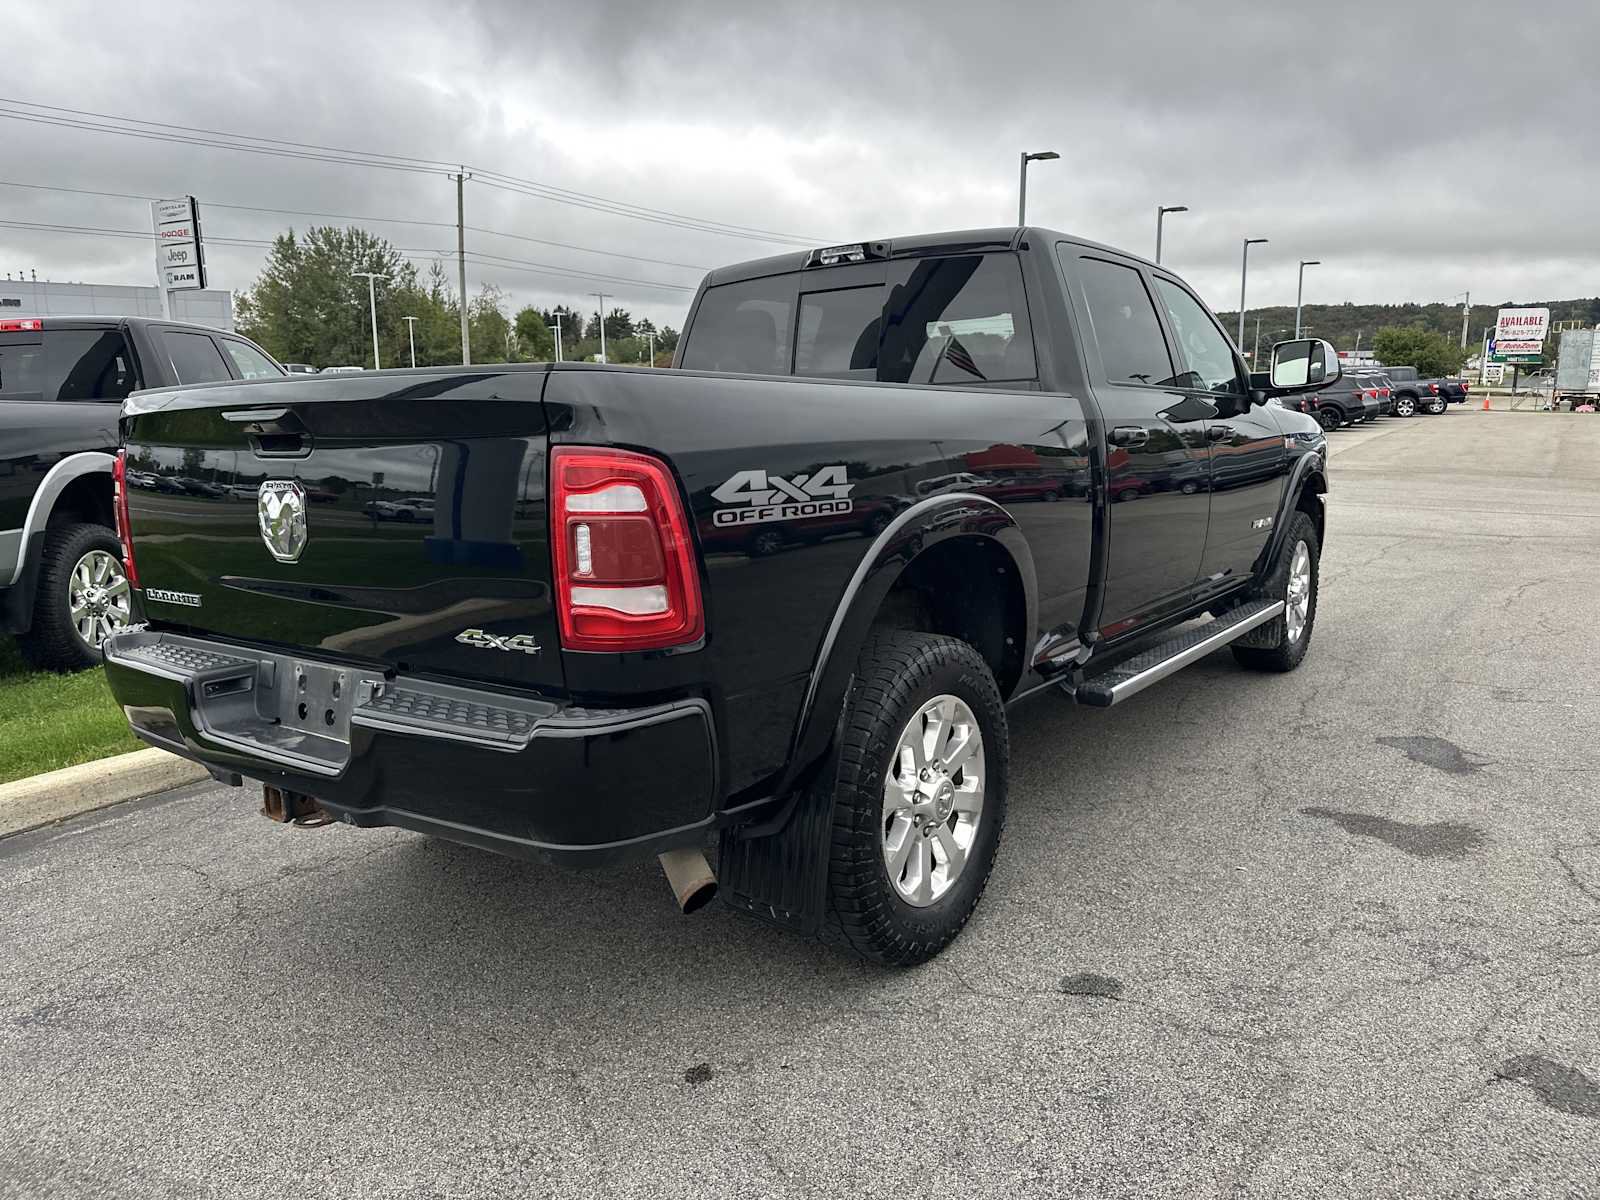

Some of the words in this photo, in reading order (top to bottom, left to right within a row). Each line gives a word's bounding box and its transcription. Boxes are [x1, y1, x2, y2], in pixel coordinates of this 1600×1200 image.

[161, 228, 190, 238] DODGE
[168, 249, 187, 262] Jeep
[174, 273, 195, 281] RAM
[1500, 316, 1544, 326] AVAILABLE
[717, 507, 775, 524] OFF
[782, 501, 850, 518] ROAD
